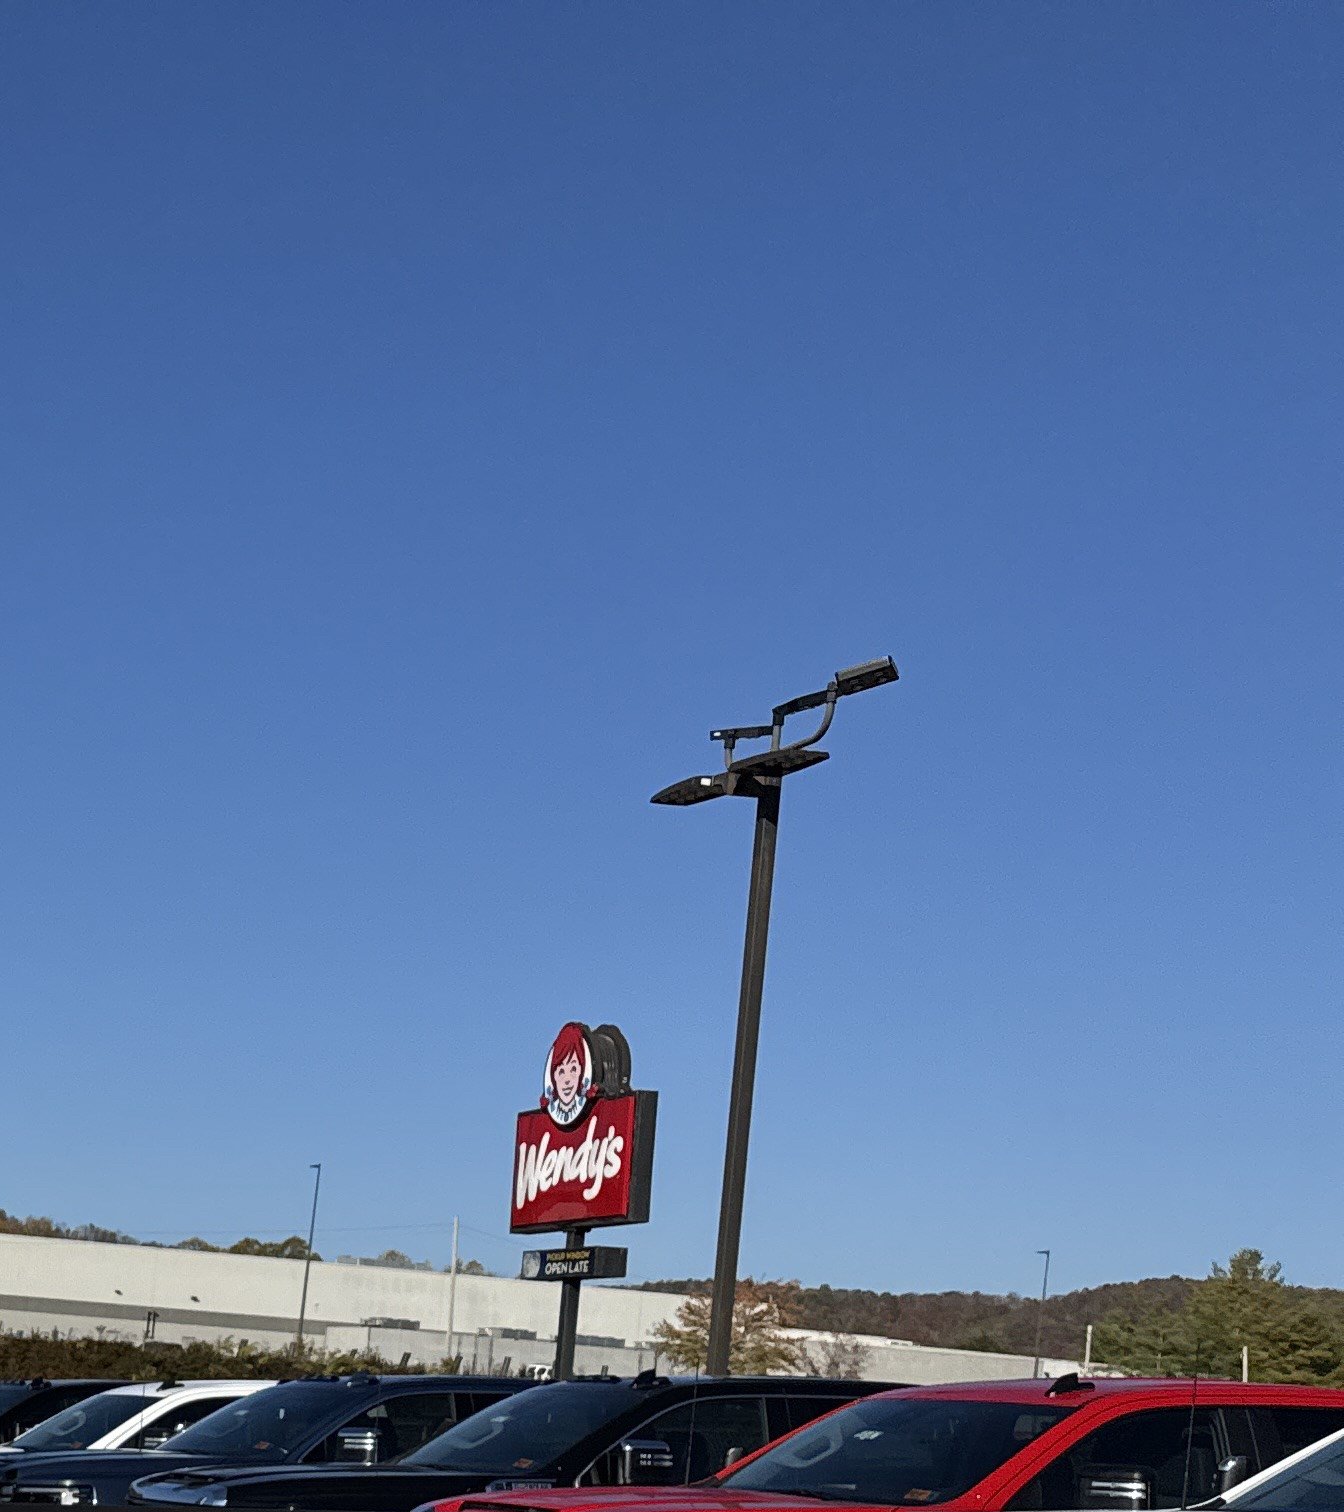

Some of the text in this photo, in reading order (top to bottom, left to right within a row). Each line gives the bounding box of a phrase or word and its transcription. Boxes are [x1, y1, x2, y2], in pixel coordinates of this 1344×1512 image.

[516, 1115, 624, 1210] Wendy's
[544, 1260, 590, 1275] OPEN LATE
